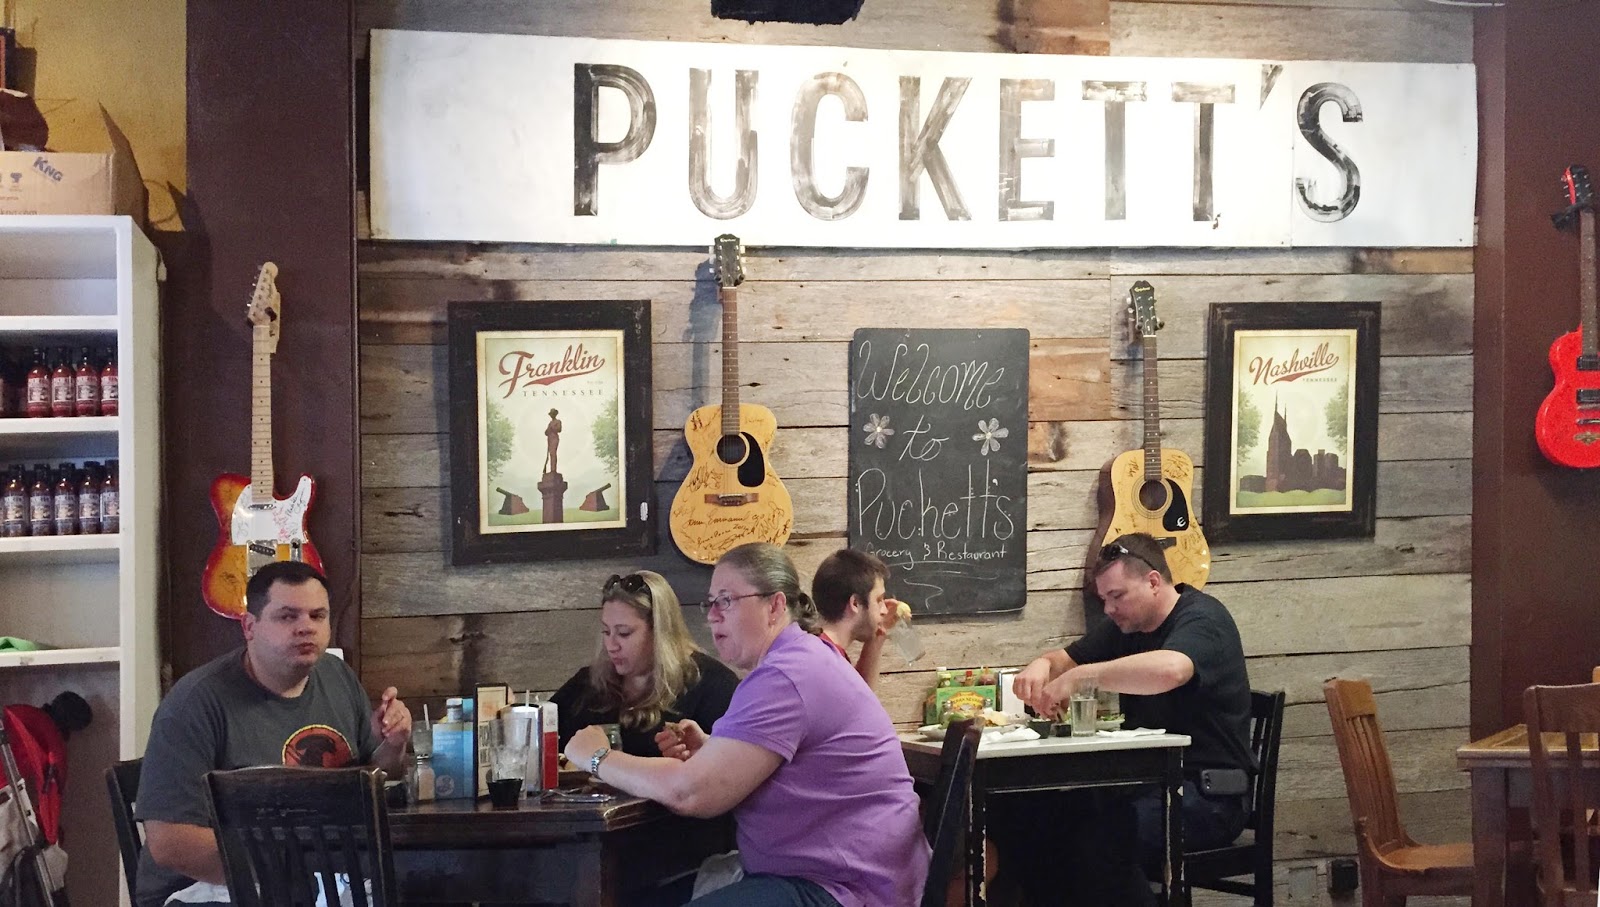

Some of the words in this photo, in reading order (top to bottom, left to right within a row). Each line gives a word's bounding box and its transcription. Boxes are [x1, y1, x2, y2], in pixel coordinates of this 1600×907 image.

[574, 63, 1364, 223] PUCKETT'S
[33, 156, 64, 182] KNG
[498, 343, 606, 399] Franklin
[1249, 342, 1340, 385] Nashville
[523, 389, 603, 397] TENNESSEE
[898, 414, 950, 461] to
[865, 542, 914, 571] Grocery
[937, 541, 1008, 560] Restaurant
